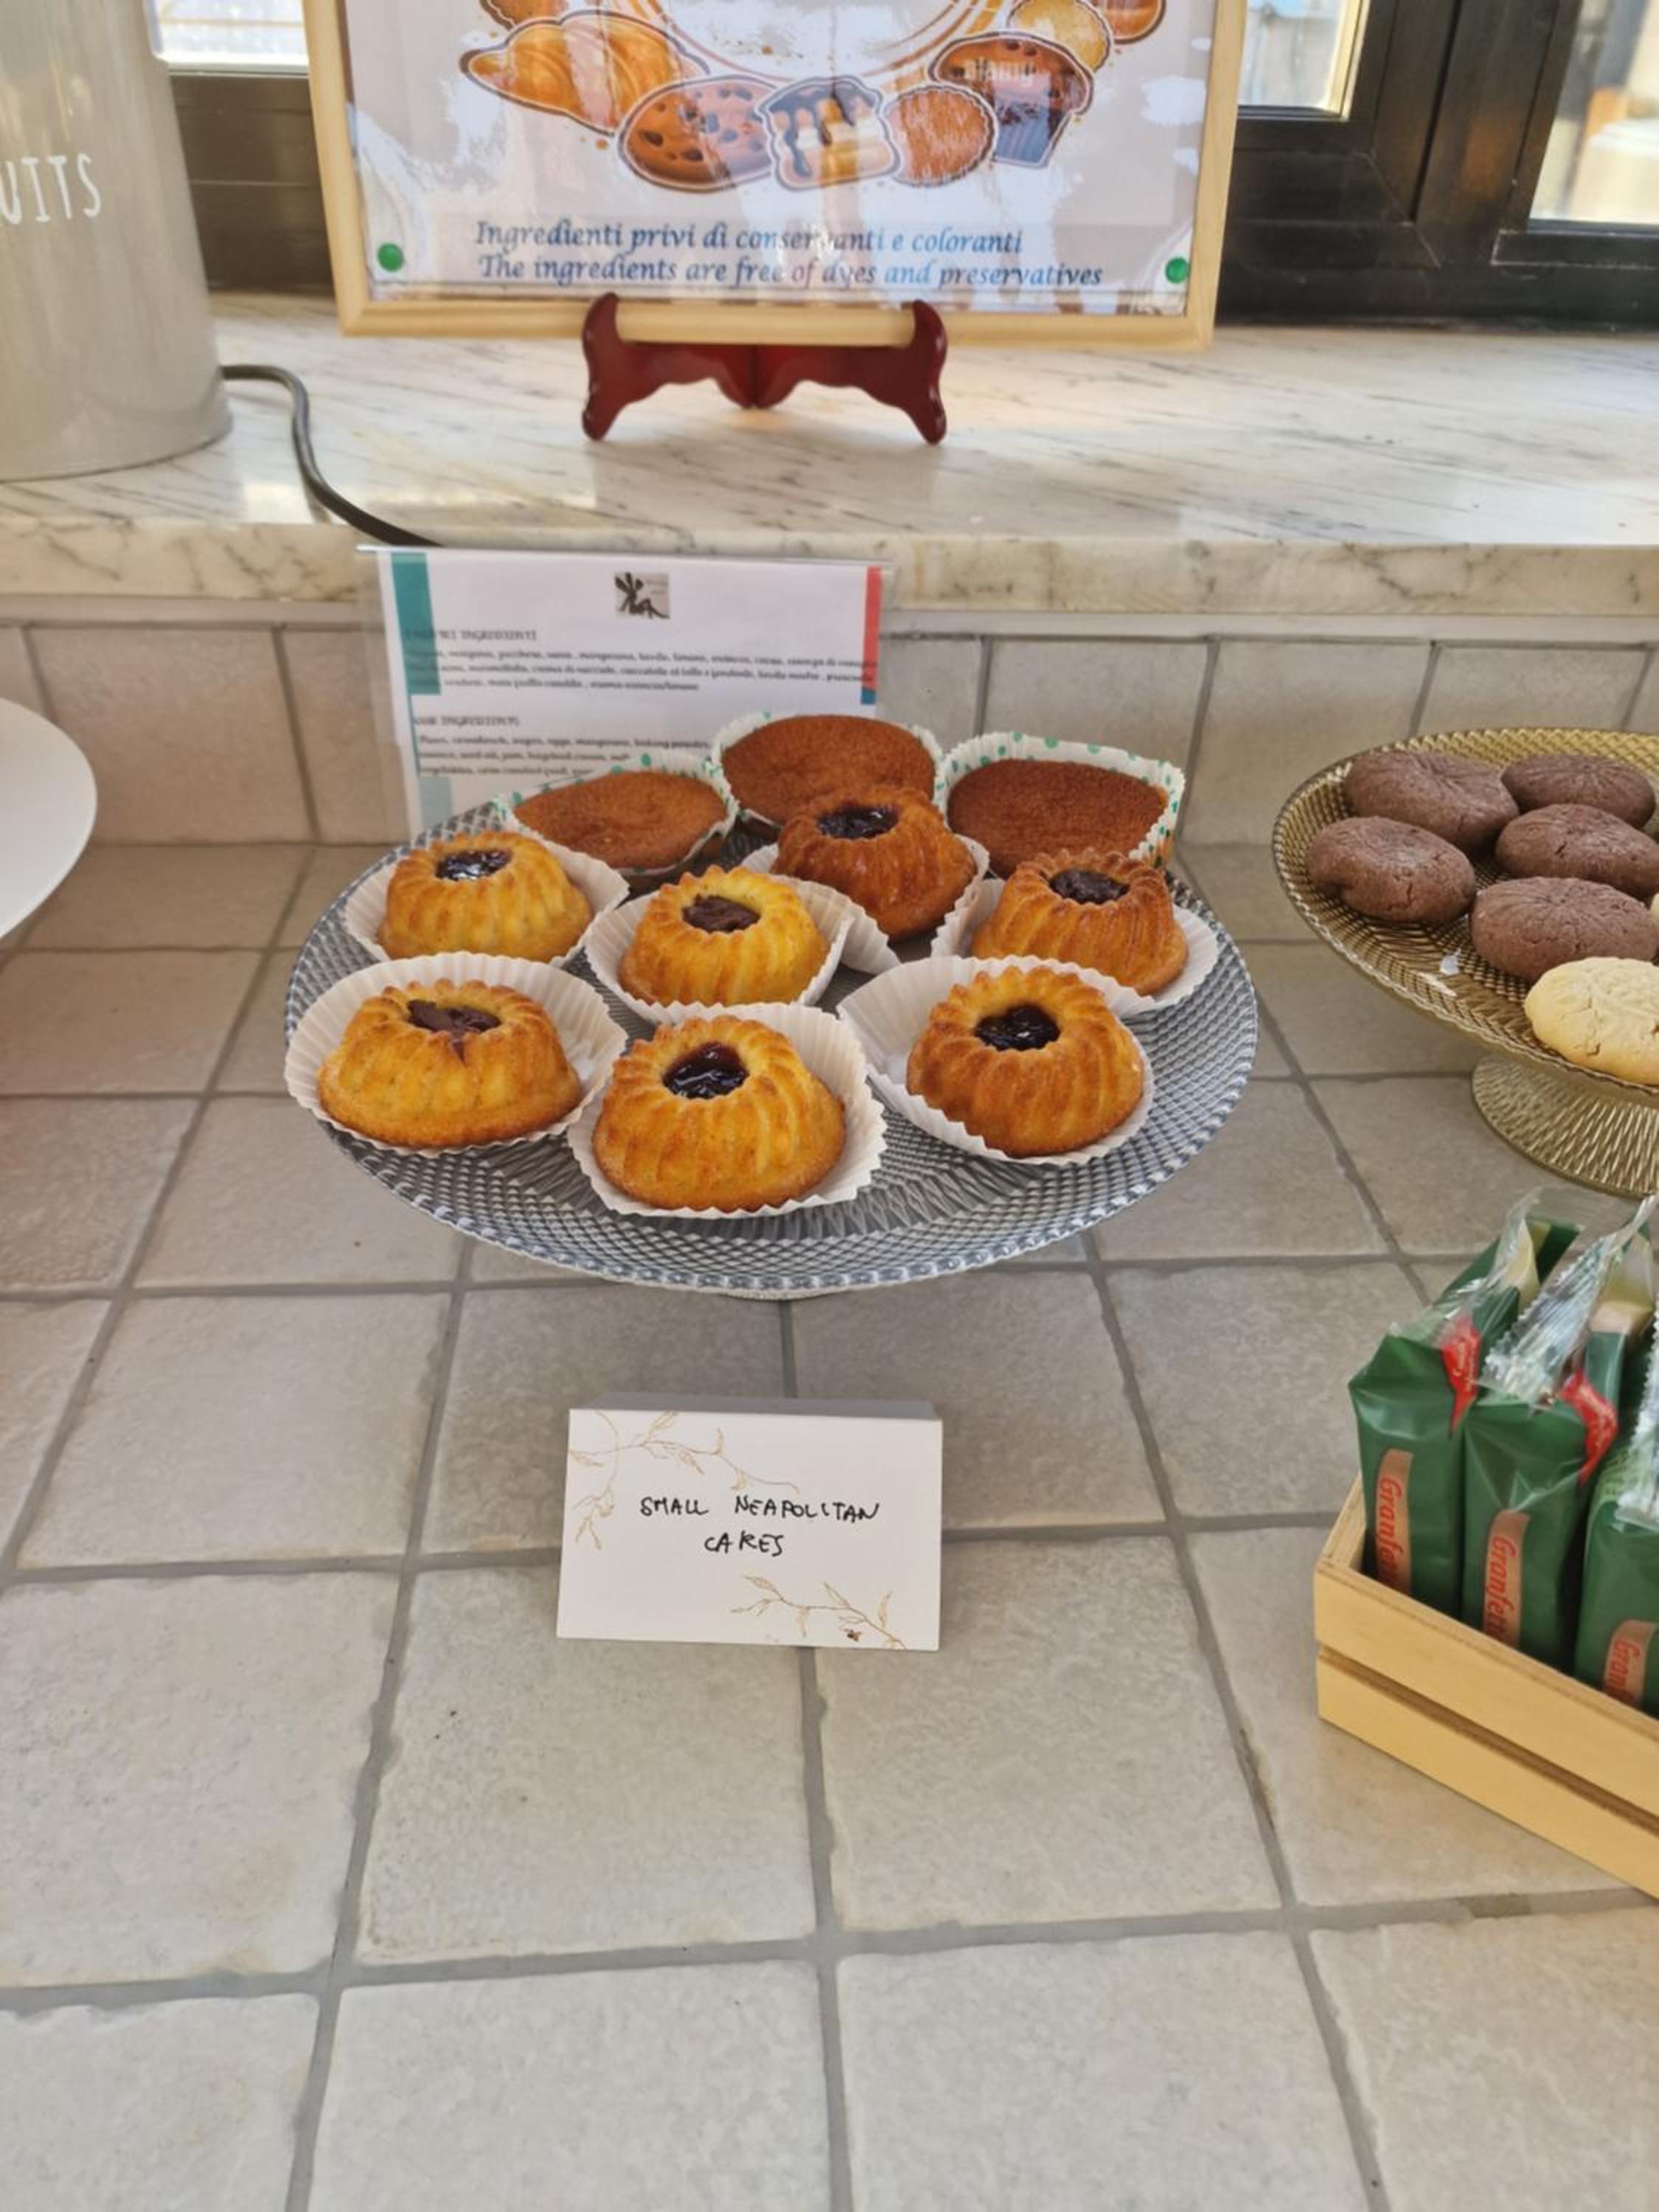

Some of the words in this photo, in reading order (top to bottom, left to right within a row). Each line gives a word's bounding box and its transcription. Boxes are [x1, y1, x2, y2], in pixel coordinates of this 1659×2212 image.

[476, 219, 623, 254] Ingredienti
[625, 223, 695, 254] privi
[703, 222, 727, 248] di
[891, 236, 904, 253] e
[911, 226, 1024, 254] coloranti
[479, 254, 525, 279] The
[534, 252, 677, 287] ingredients
[686, 262, 728, 283] are
[733, 256, 784, 290] free
[790, 258, 815, 288] of
[885, 260, 936, 285] and
[937, 262, 1104, 291] preservatives
[639, 1495, 709, 1517] SMALL
[734, 1495, 880, 1524] NEAPOLITAN
[704, 1531, 785, 1557] CAKES
